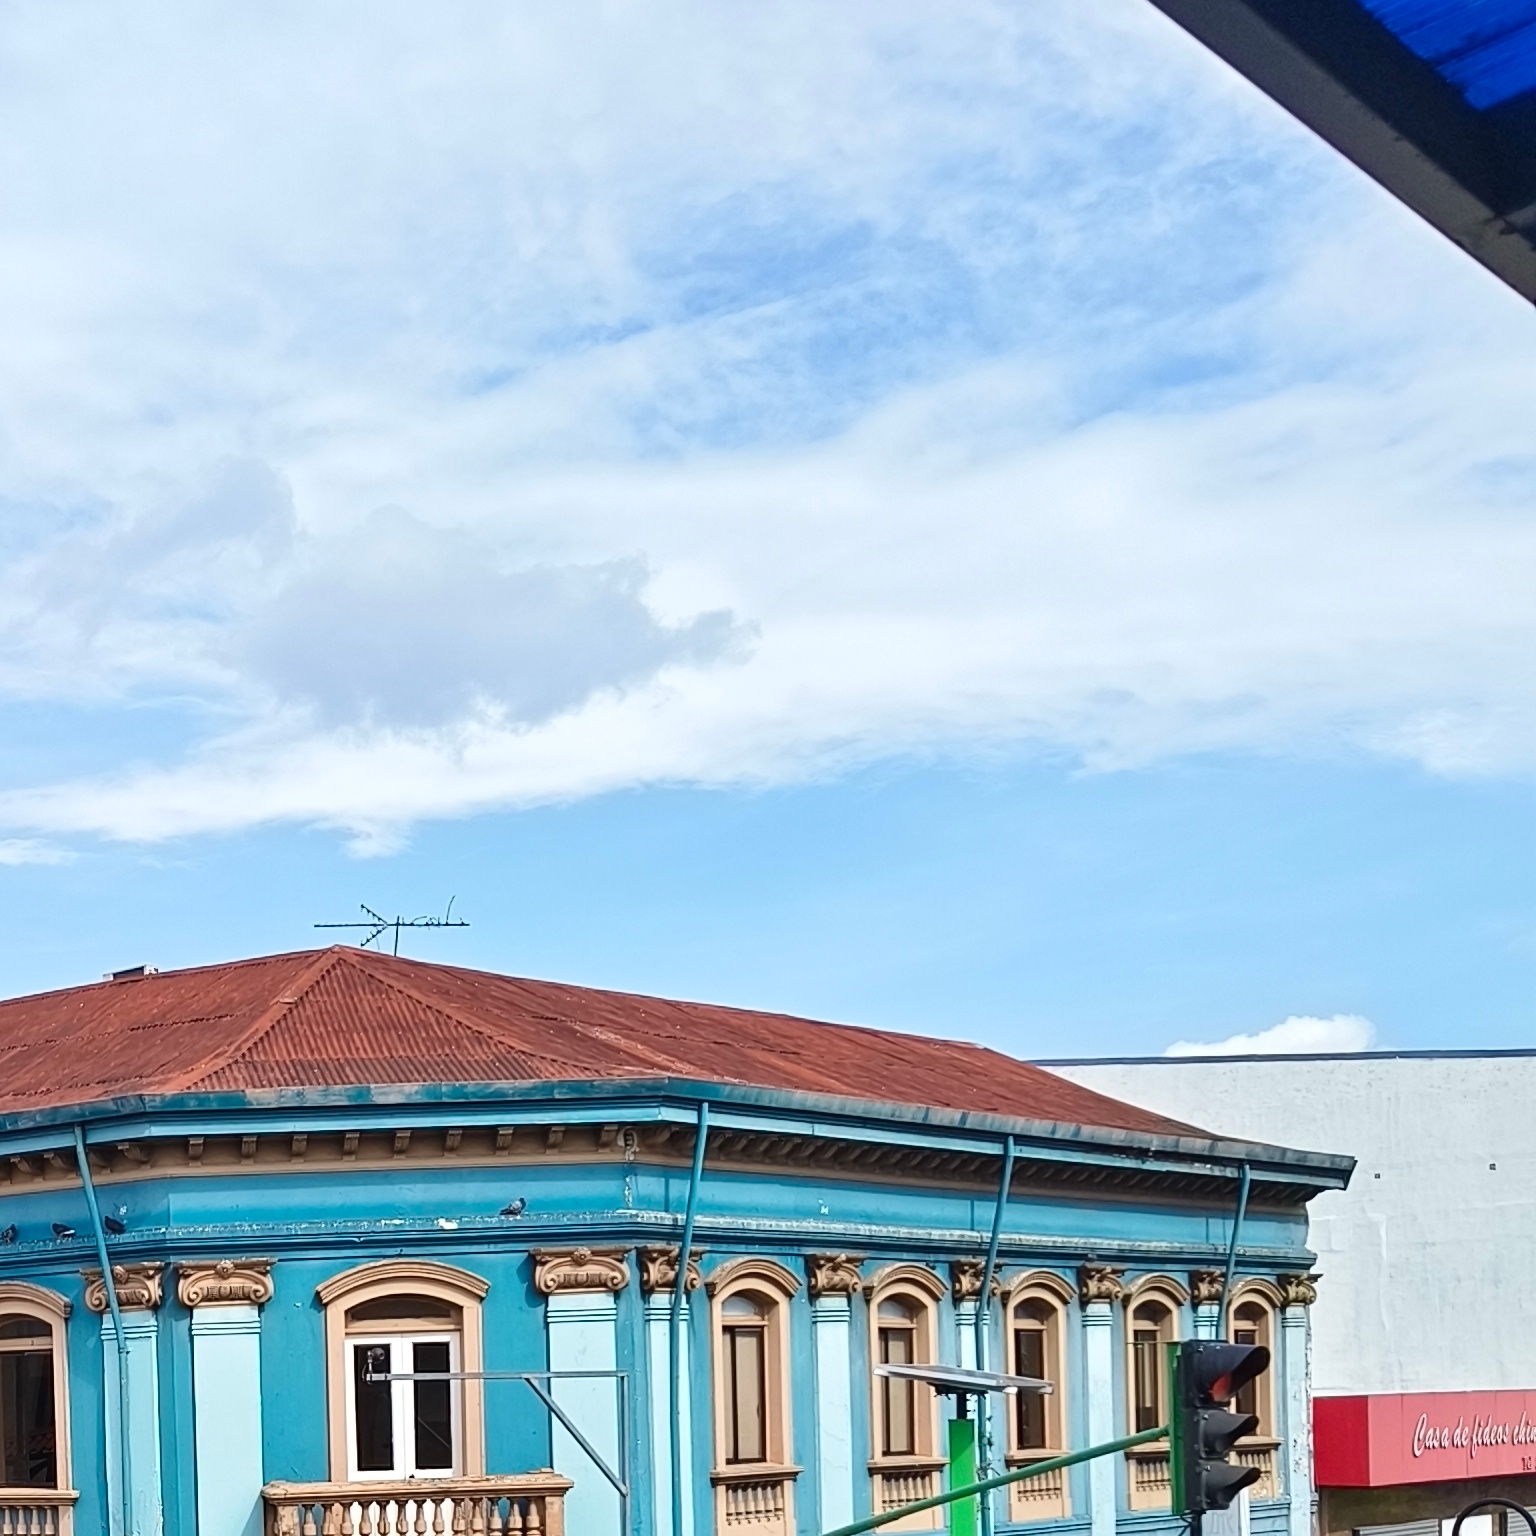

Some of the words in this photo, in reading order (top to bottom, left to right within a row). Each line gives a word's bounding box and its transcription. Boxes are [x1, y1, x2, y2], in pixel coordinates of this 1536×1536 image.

[1413, 1412, 1449, 1458] Casa
[1453, 1416, 1469, 1448] de
[1471, 1414, 1509, 1459] fideos
